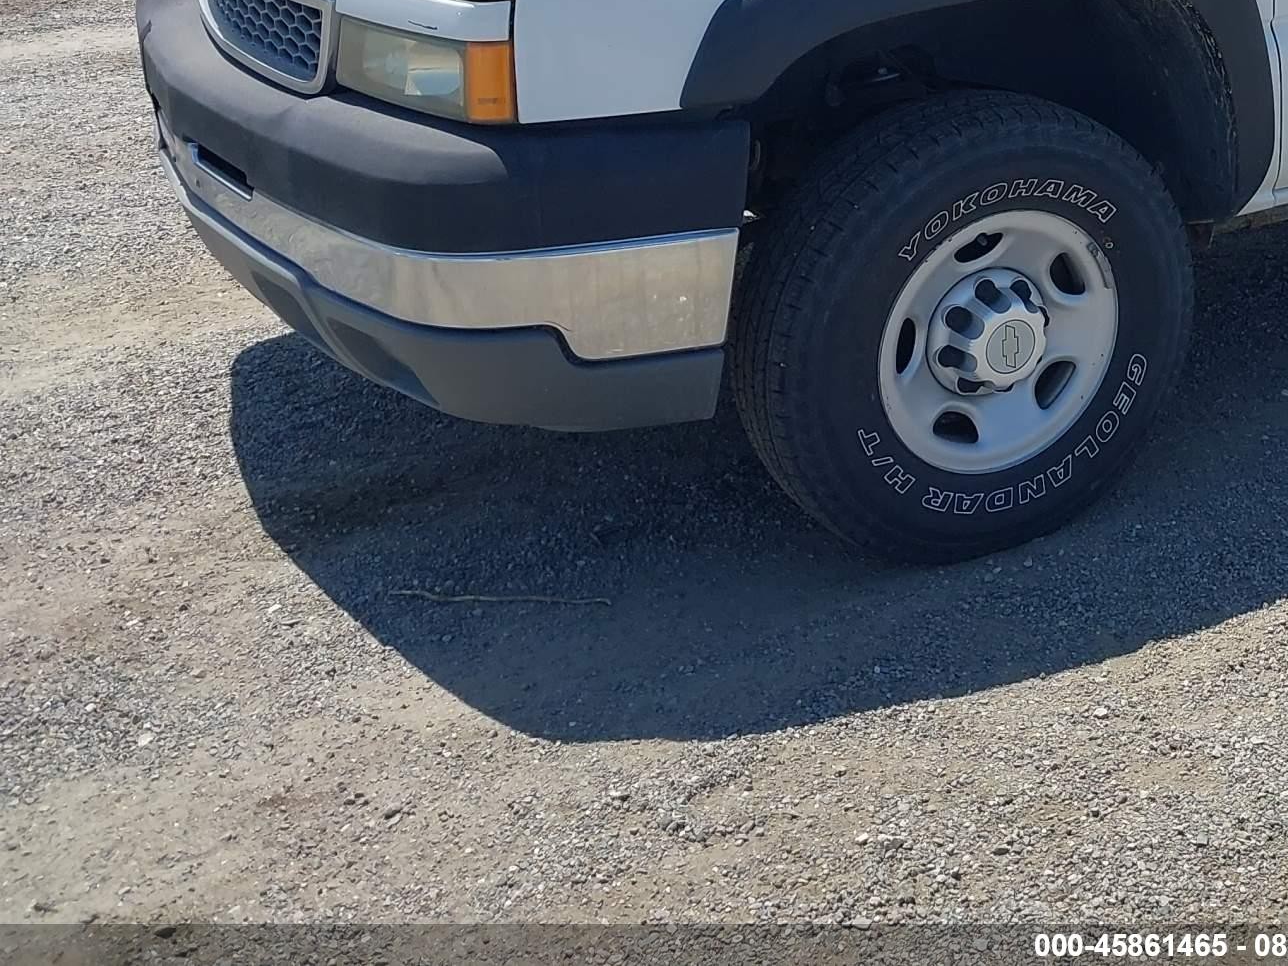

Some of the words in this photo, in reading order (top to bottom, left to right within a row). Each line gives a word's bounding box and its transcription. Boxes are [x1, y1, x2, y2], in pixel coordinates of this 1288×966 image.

[898, 178, 1117, 261] YOKOHAMA
[857, 429, 916, 494] H/T
[921, 353, 1148, 515] GEOLANDAR
